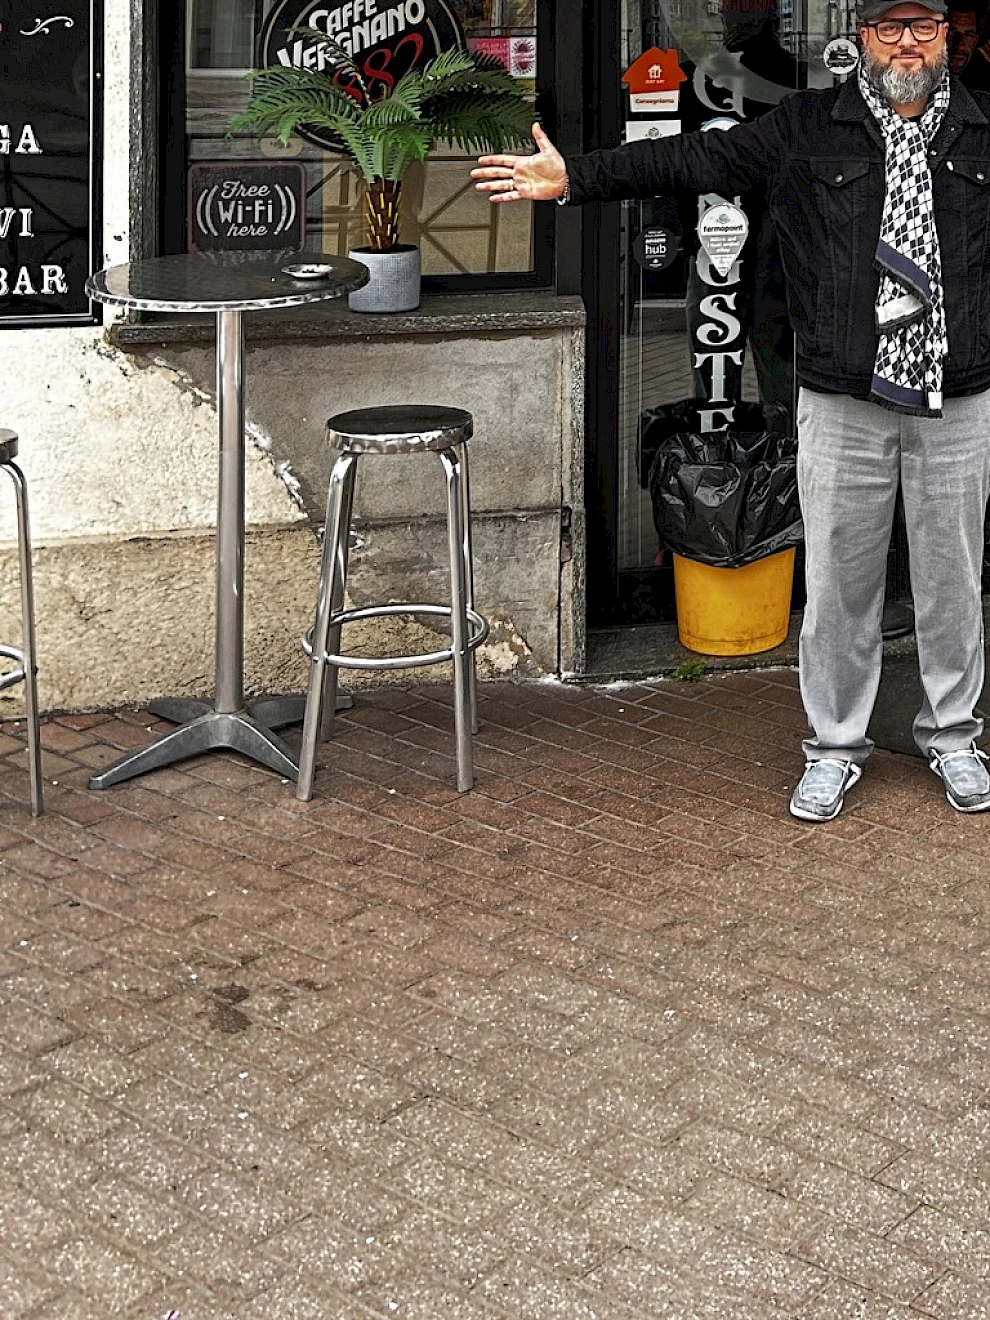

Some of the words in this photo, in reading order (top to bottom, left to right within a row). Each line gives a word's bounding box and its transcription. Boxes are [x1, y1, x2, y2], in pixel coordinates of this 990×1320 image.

[221, 180, 271, 199] Free
[217, 200, 273, 223] Wi-Fi
[226, 223, 268, 237] here
[645, 243, 667, 254] hub
